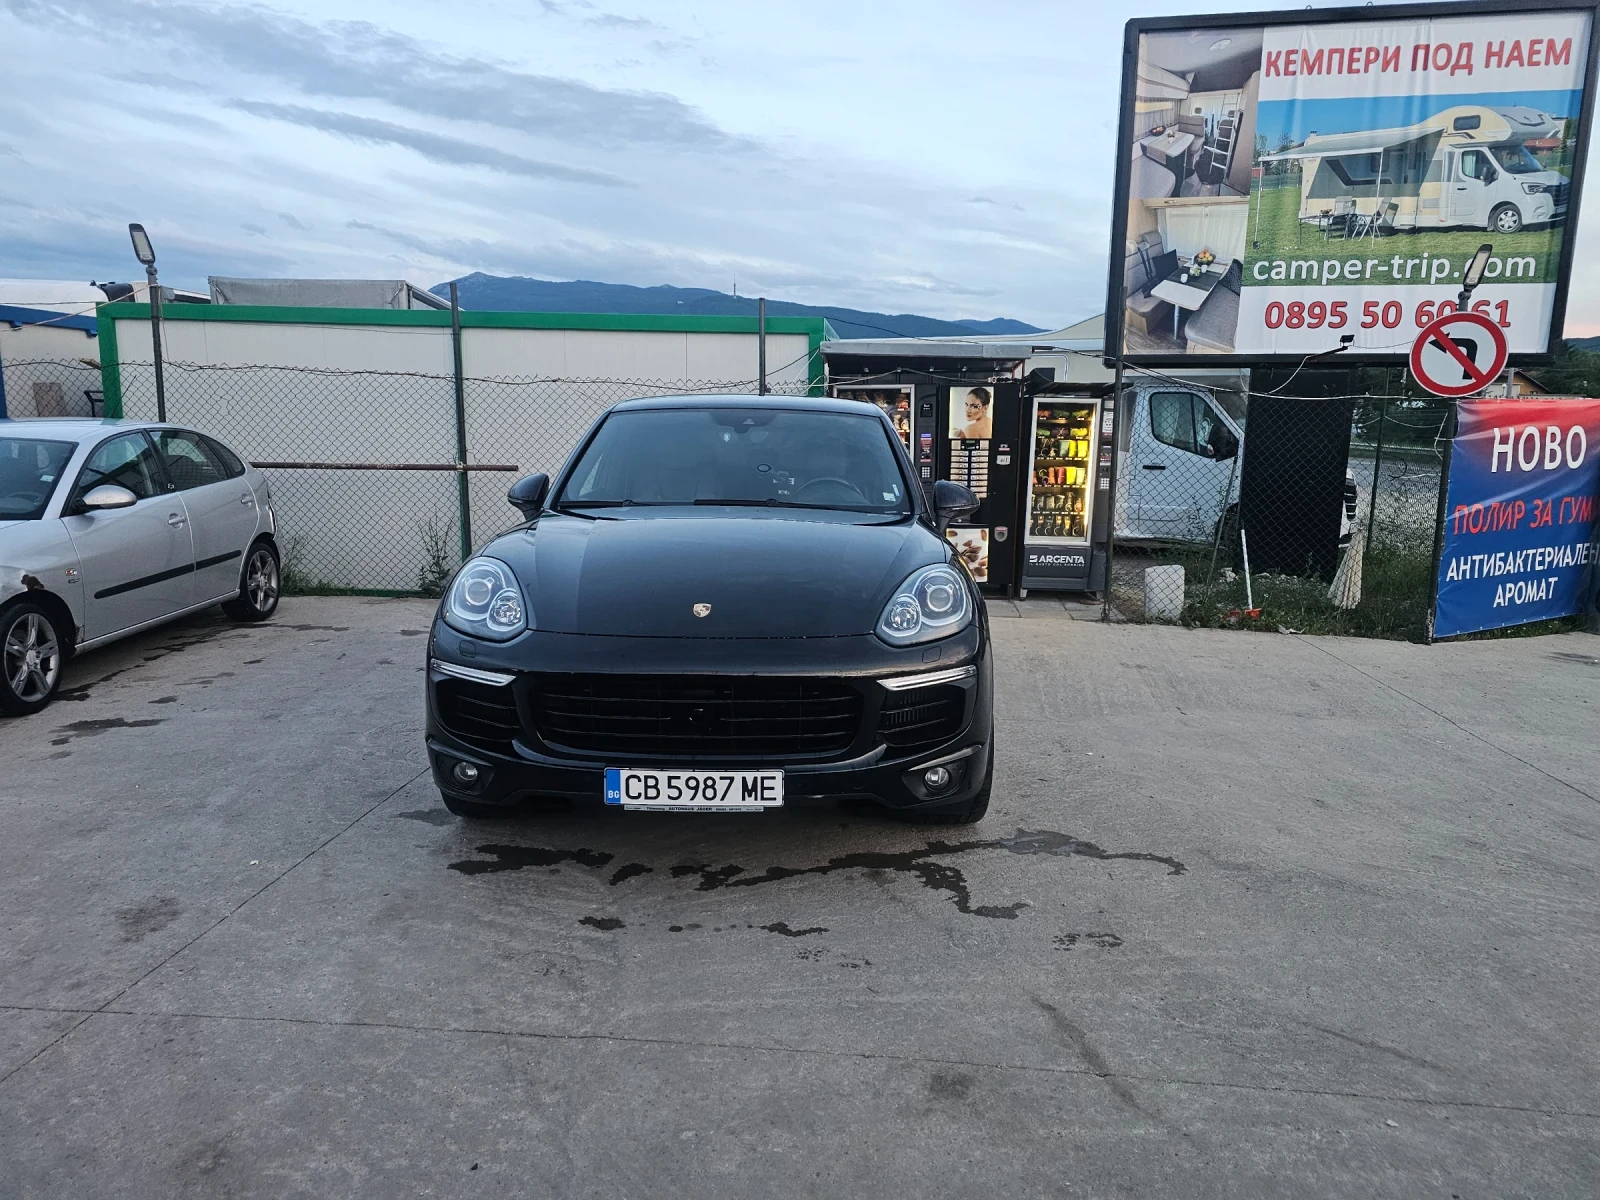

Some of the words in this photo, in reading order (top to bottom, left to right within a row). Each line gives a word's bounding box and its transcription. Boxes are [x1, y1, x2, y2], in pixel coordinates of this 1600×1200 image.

[1265, 45, 1401, 77] КЕМПЕРИ
[1411, 42, 1474, 76] ПОД
[1484, 38, 1572, 68] НАЕМ
[1264, 301, 1348, 329] 0895
[1361, 300, 1403, 329] 50
[1491, 425, 1587, 473] НОВО
[1453, 500, 1526, 535] ПОЛИР
[1529, 498, 1552, 528] ЗА
[1038, 554, 1085, 564] ARGENTA
[1493, 577, 1559, 608] АРОМАТ
[608, 790, 620, 799] BG
[625, 774, 661, 801] CB
[667, 775, 735, 802] 5987
[741, 776, 777, 802] ME
